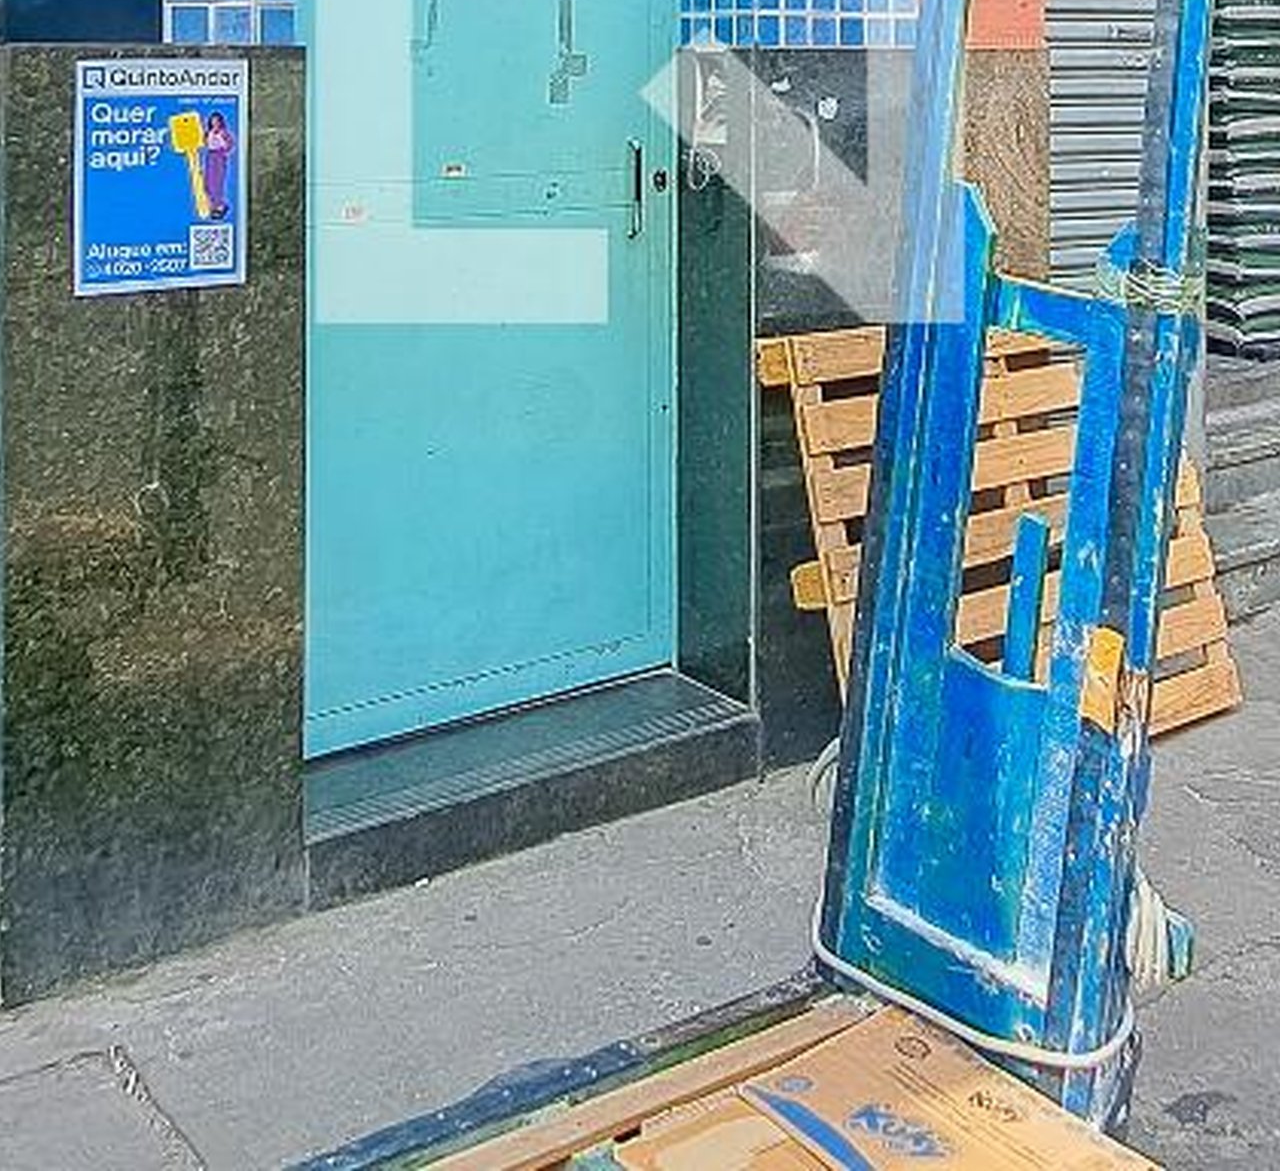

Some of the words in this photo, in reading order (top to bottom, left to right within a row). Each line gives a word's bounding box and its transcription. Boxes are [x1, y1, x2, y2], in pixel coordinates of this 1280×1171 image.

[109, 67, 240, 87] QuintoAndar
[91, 102, 157, 123] Quer
[91, 127, 168, 147] morar
[89, 145, 161, 172] aqui?
